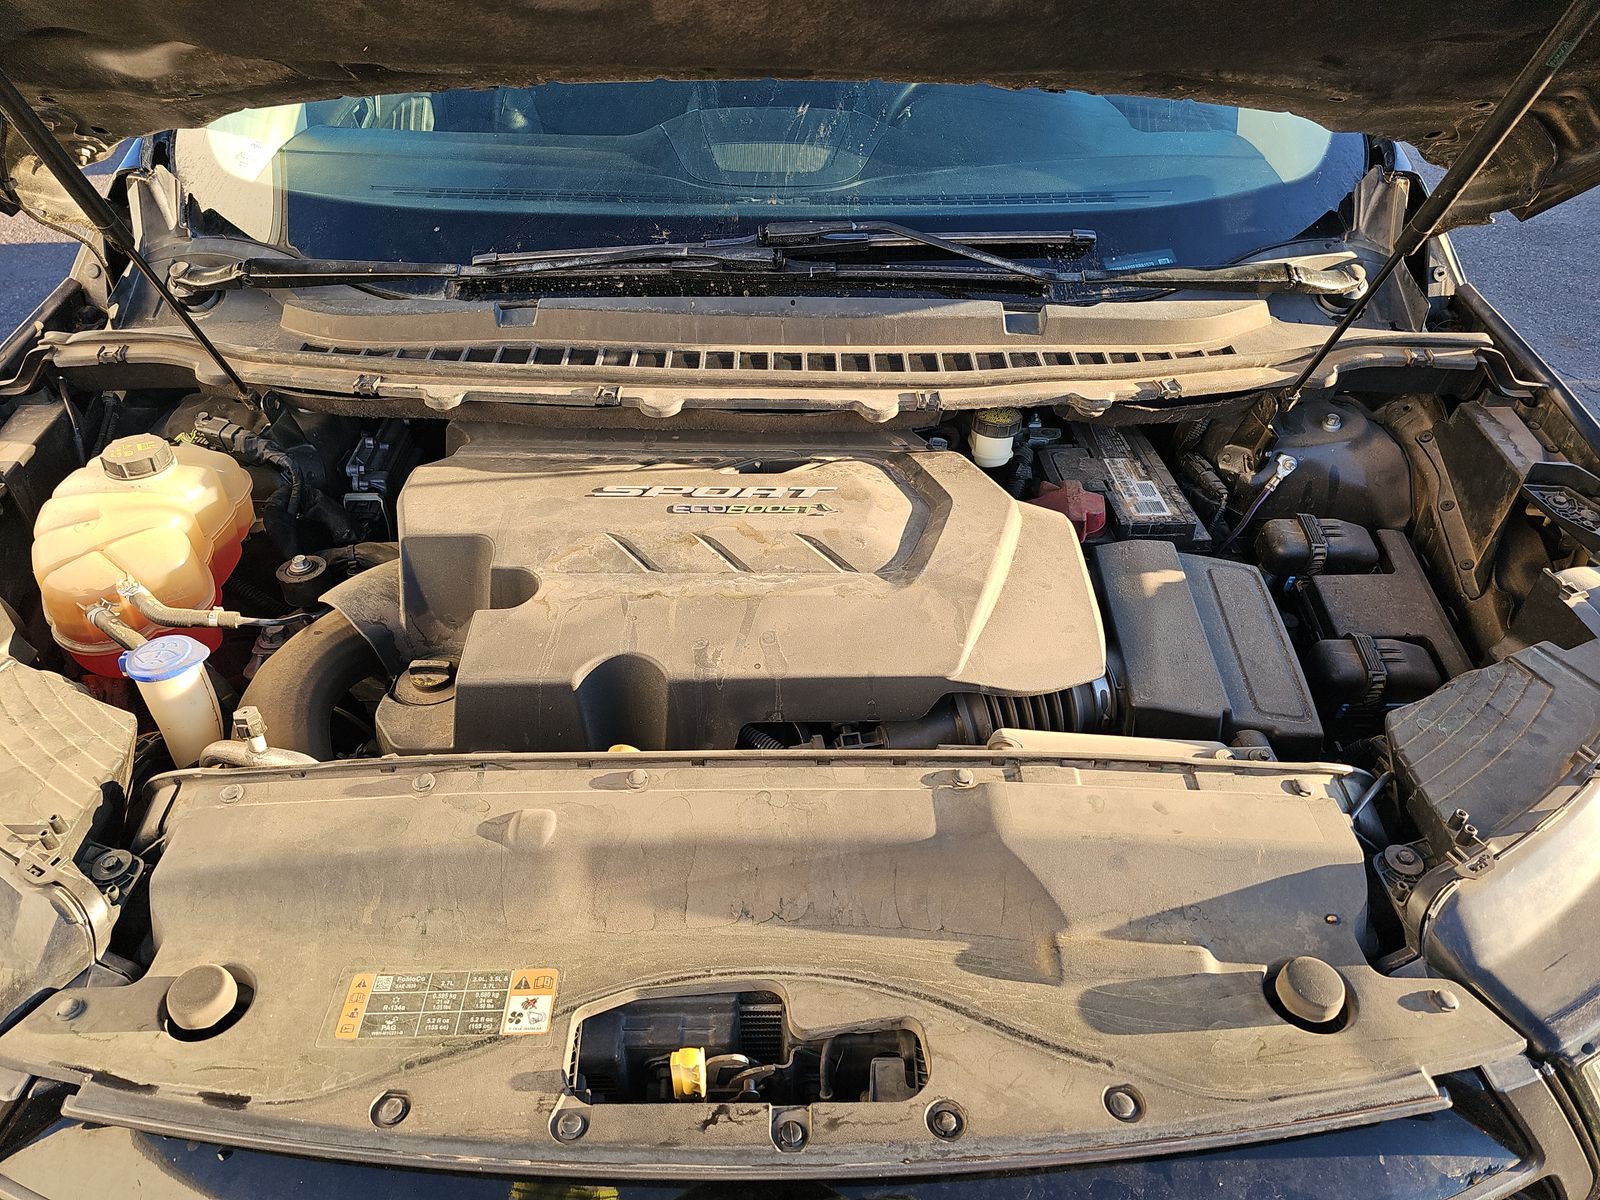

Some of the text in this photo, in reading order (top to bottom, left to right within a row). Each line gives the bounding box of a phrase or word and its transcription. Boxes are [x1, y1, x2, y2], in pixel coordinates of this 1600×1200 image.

[586, 485, 838, 499] SPORT
[396, 975, 426, 983] FoMoCo
[382, 1003, 406, 1011] R-134a
